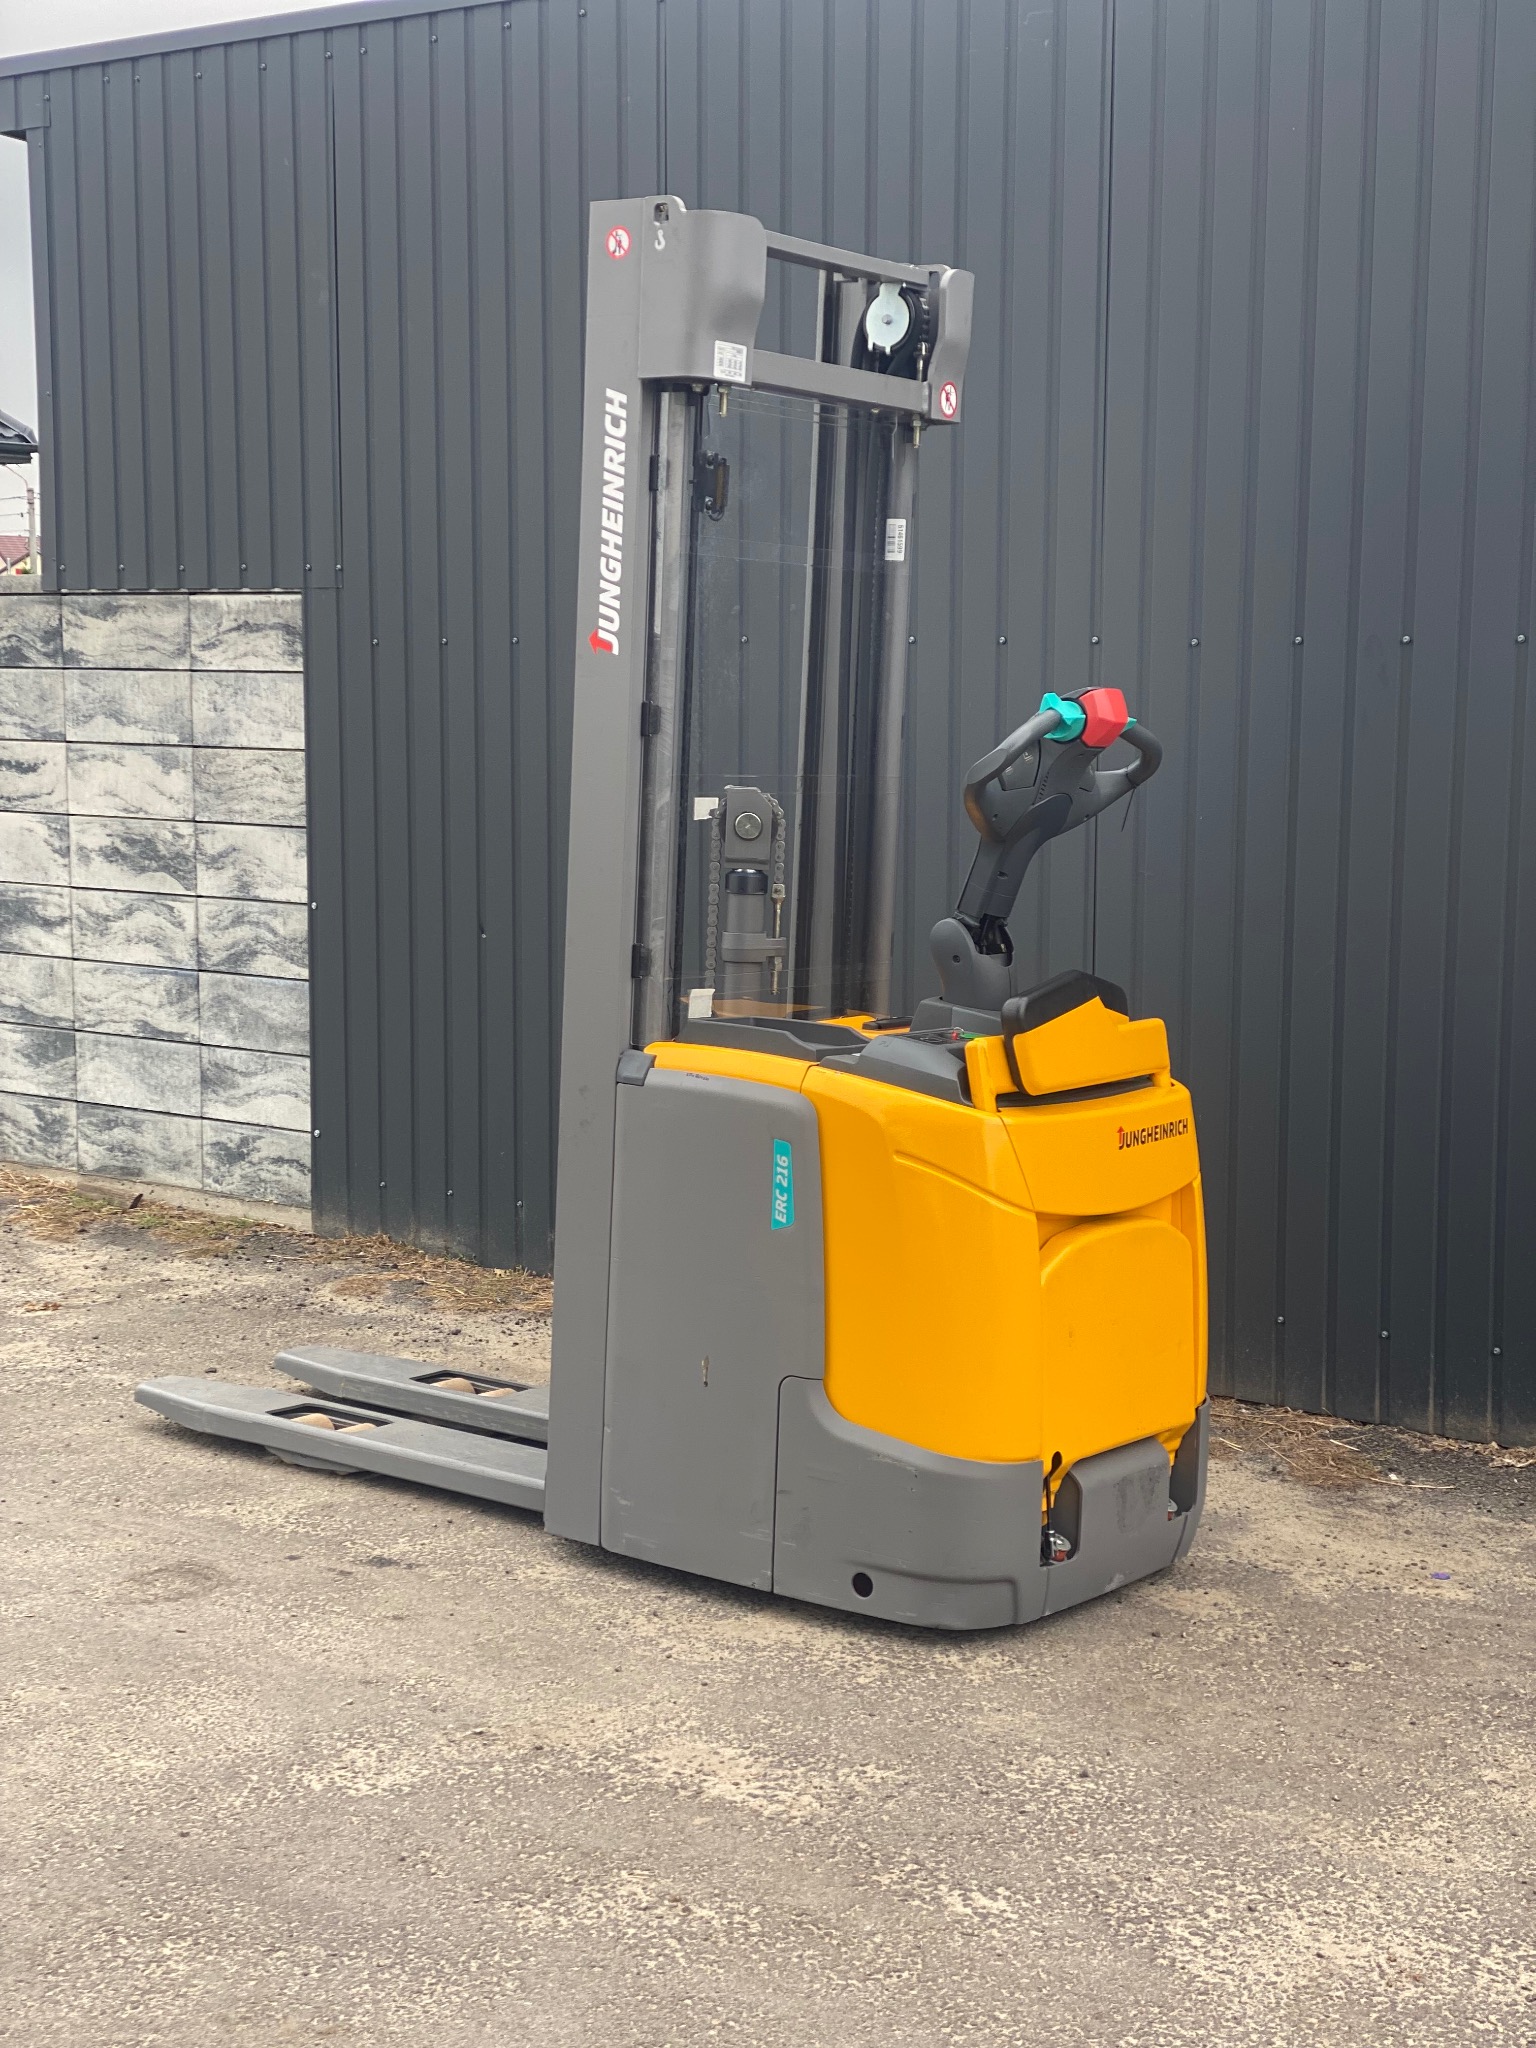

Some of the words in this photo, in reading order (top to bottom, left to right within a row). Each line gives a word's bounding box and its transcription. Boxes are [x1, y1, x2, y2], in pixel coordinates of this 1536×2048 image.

[589, 387, 628, 655] JUNGHEINRICH
[1117, 1118, 1188, 1150] JUNGHEINRICH
[776, 1154, 789, 1187] 216
[775, 1189, 788, 1223] ERC
